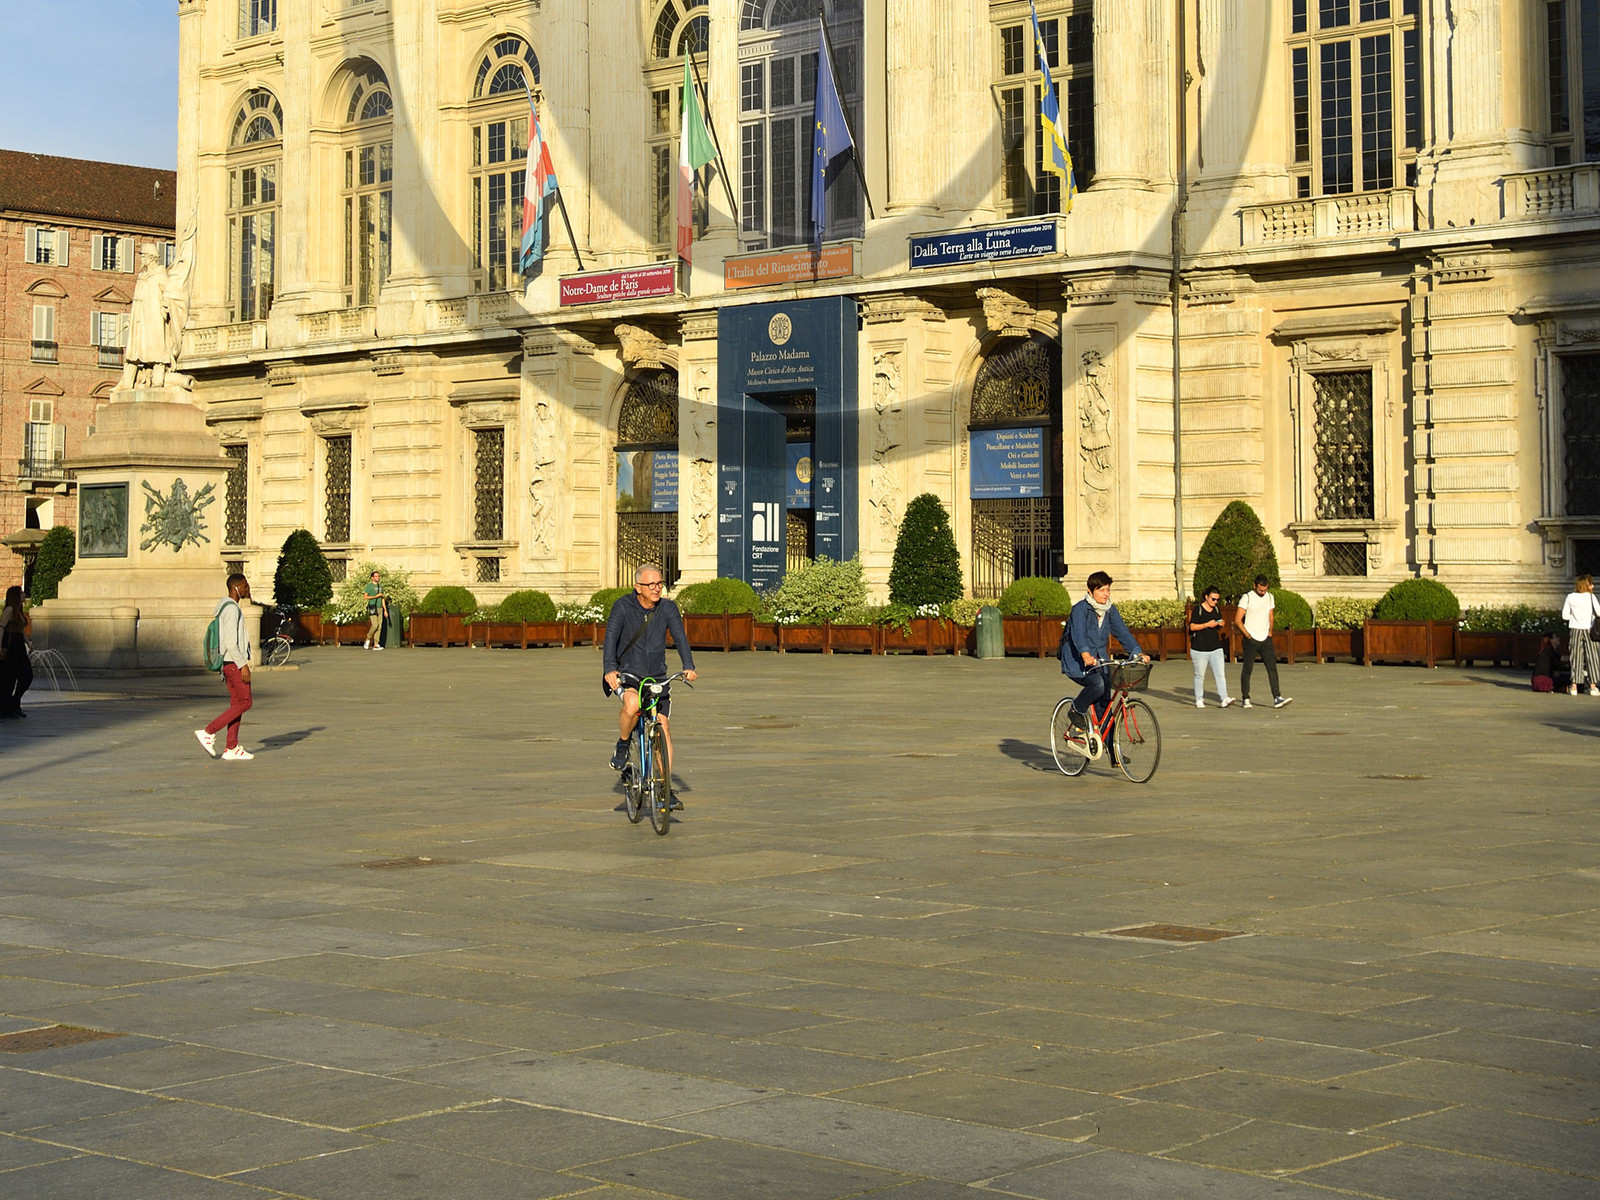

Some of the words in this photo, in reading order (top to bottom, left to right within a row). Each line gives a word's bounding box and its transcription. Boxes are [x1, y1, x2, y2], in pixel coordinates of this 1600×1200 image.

[914, 244, 938, 258] Dalla
[940, 242, 964, 254] Terra
[967, 238, 983, 251] alla
[986, 238, 1011, 249] Luna
[960, 252, 973, 260] L'arte
[980, 250, 998, 259] viaggio
[1013, 246, 1027, 254] l'astro
[1029, 245, 1052, 254] d'argento
[727, 266, 753, 279] L'Italia
[756, 264, 768, 276] del
[771, 260, 828, 274] Rinascimento
[563, 282, 608, 296] Notre-Dame
[610, 280, 618, 291] de
[621, 279, 638, 290] Paris
[751, 351, 777, 362] Palazzo
[779, 348, 810, 360] Madama
[747, 368, 763, 376] Museo
[781, 365, 796, 373] d'Arte
[797, 364, 814, 372] Antica
[996, 433, 1014, 441] Dipinti
